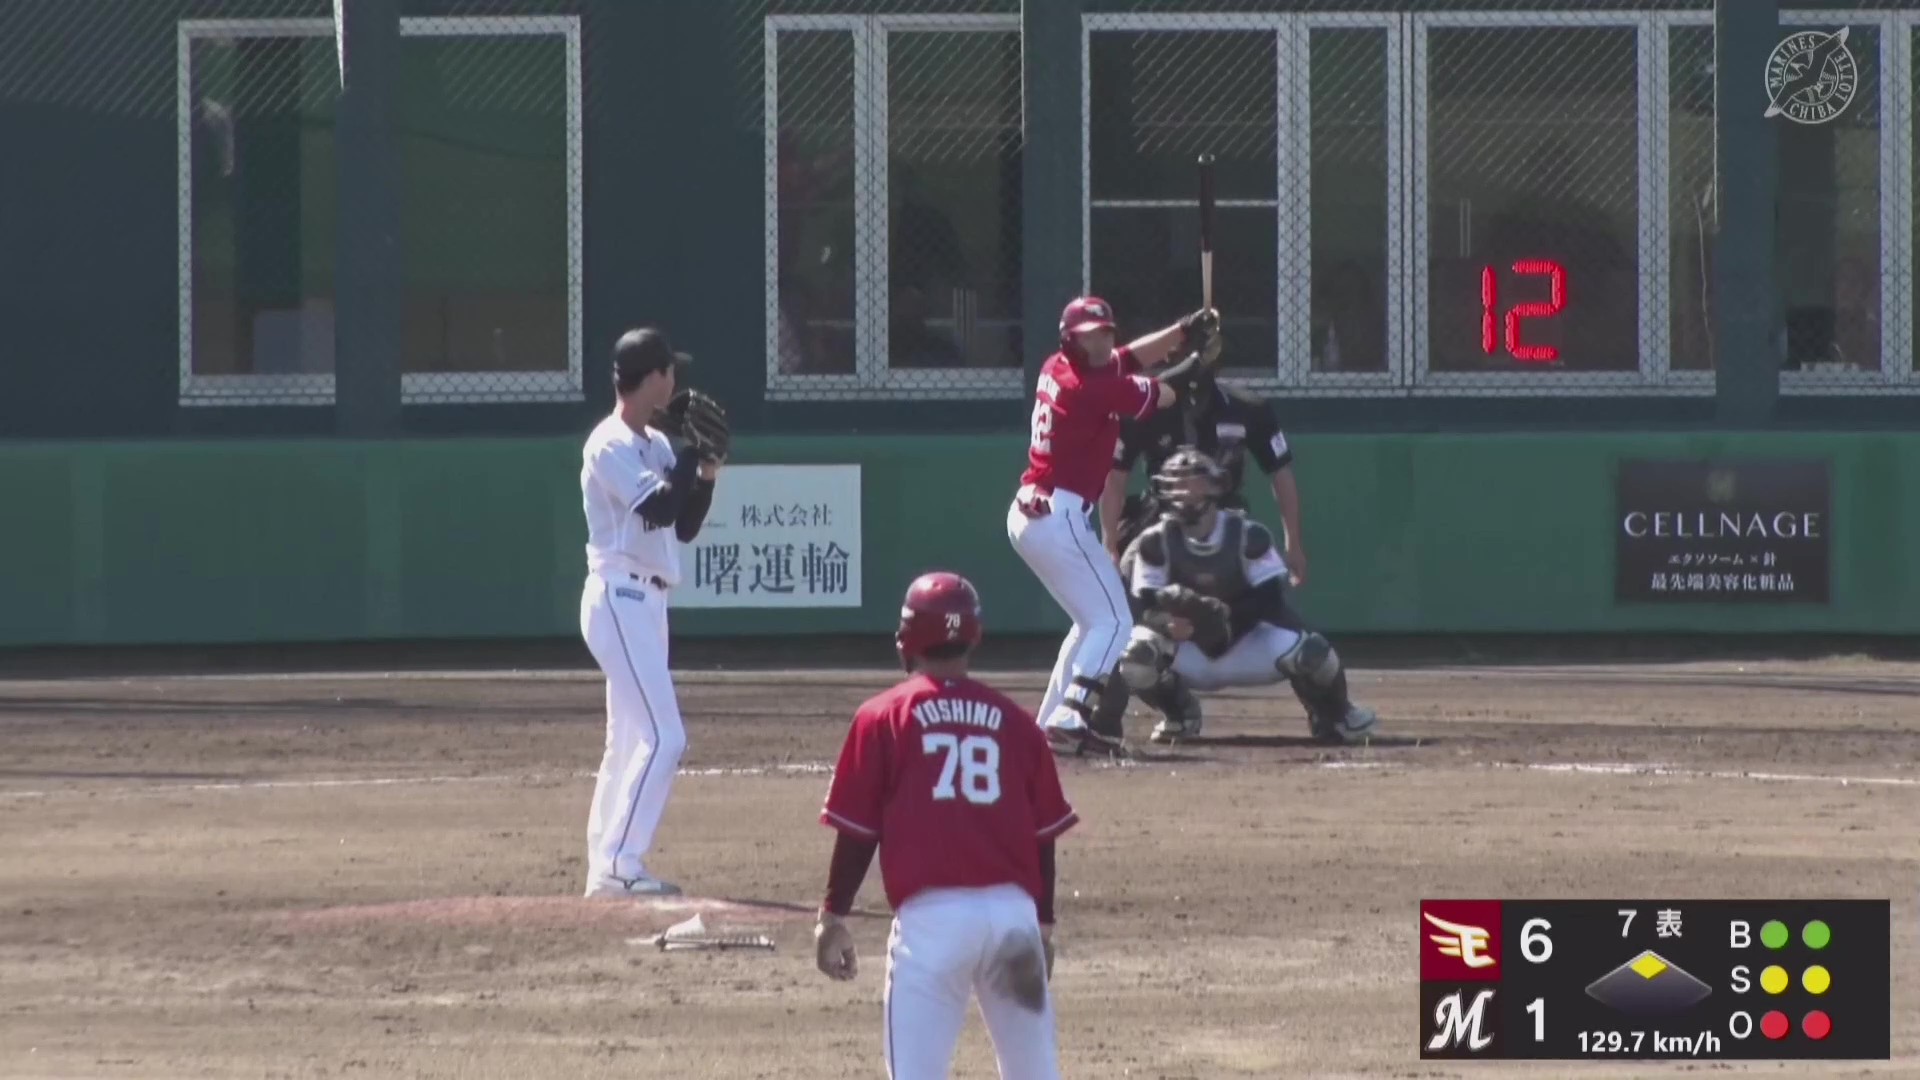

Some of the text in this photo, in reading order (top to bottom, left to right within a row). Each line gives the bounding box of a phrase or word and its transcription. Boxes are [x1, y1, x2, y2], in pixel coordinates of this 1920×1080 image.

[1482, 259, 1567, 361] 12
[741, 503, 832, 528] 株式会社
[1624, 511, 1820, 538] CELLNAGE
[695, 541, 851, 596] 曙運輸
[1651, 573, 1795, 591] 最先端美容化粧品
[945, 613, 961, 628] 78
[913, 699, 1003, 730] YOSHINO
[921, 732, 1002, 805] 78
